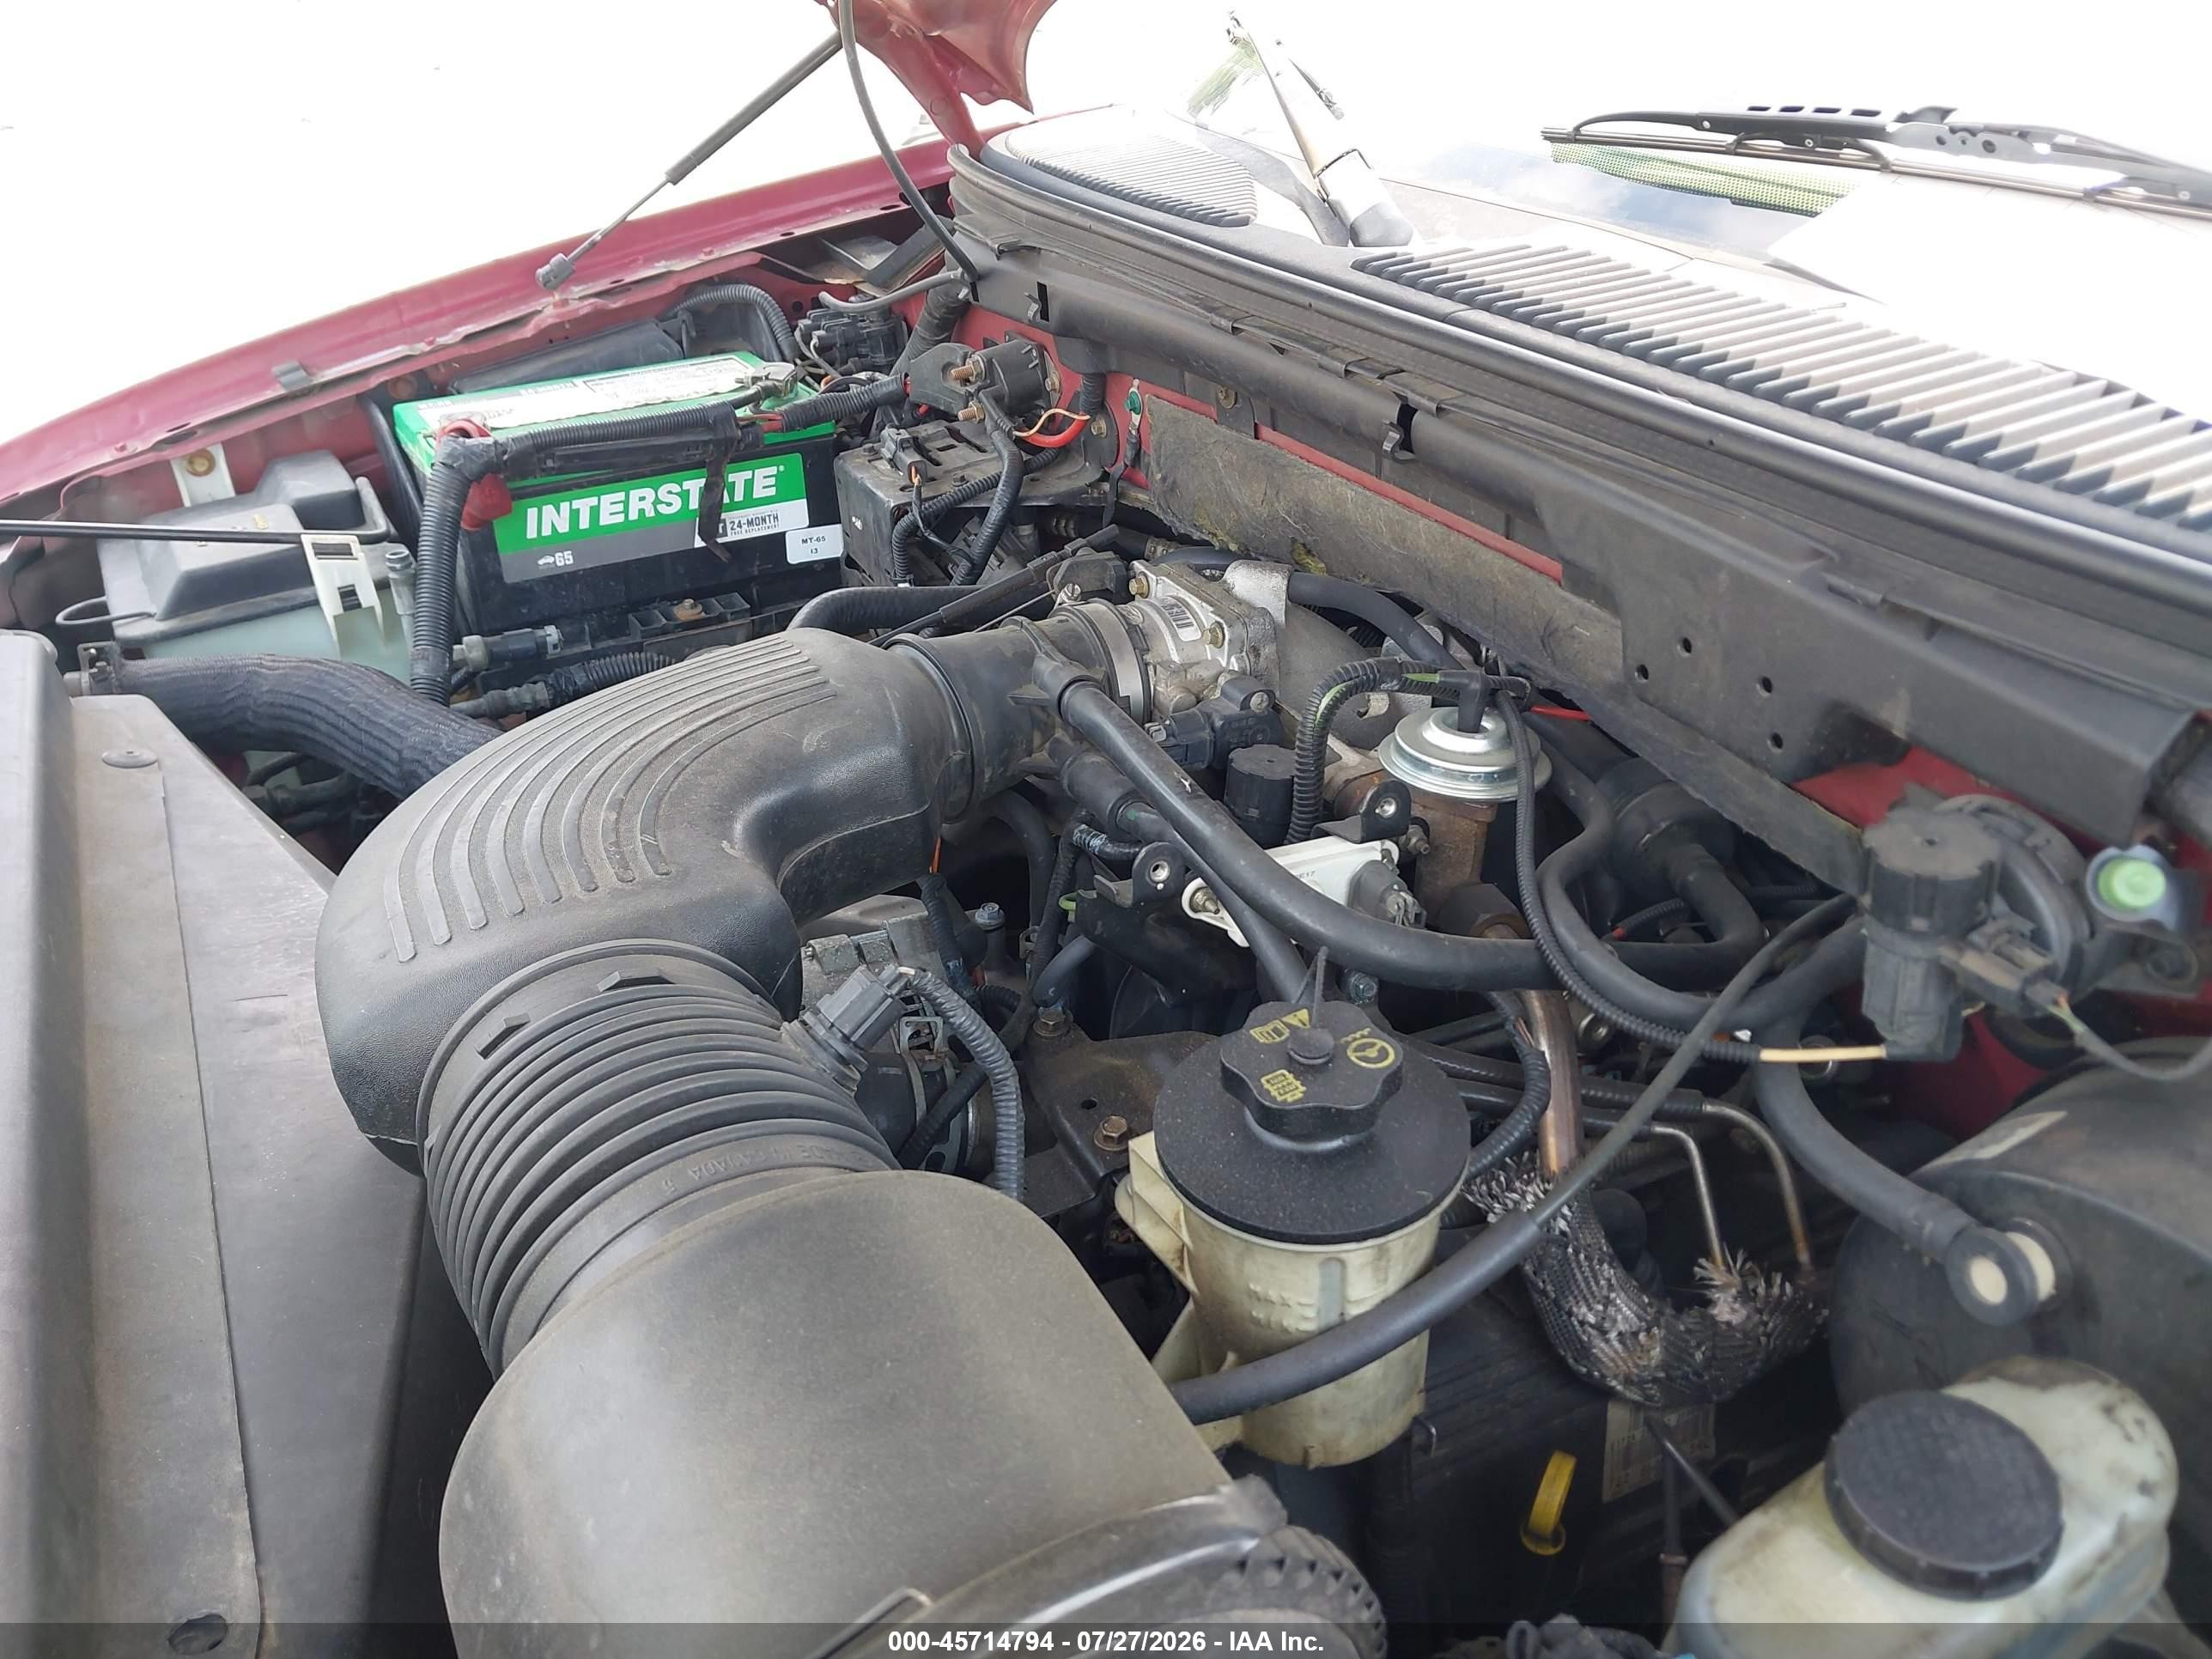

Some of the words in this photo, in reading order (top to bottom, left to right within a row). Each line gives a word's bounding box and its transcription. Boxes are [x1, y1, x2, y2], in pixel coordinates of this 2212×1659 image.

[526, 465, 778, 539] INTERSTTE
[730, 513, 779, 531] 24-MONTH
[801, 536, 826, 544] MT-65
[555, 550, 574, 567] 65
